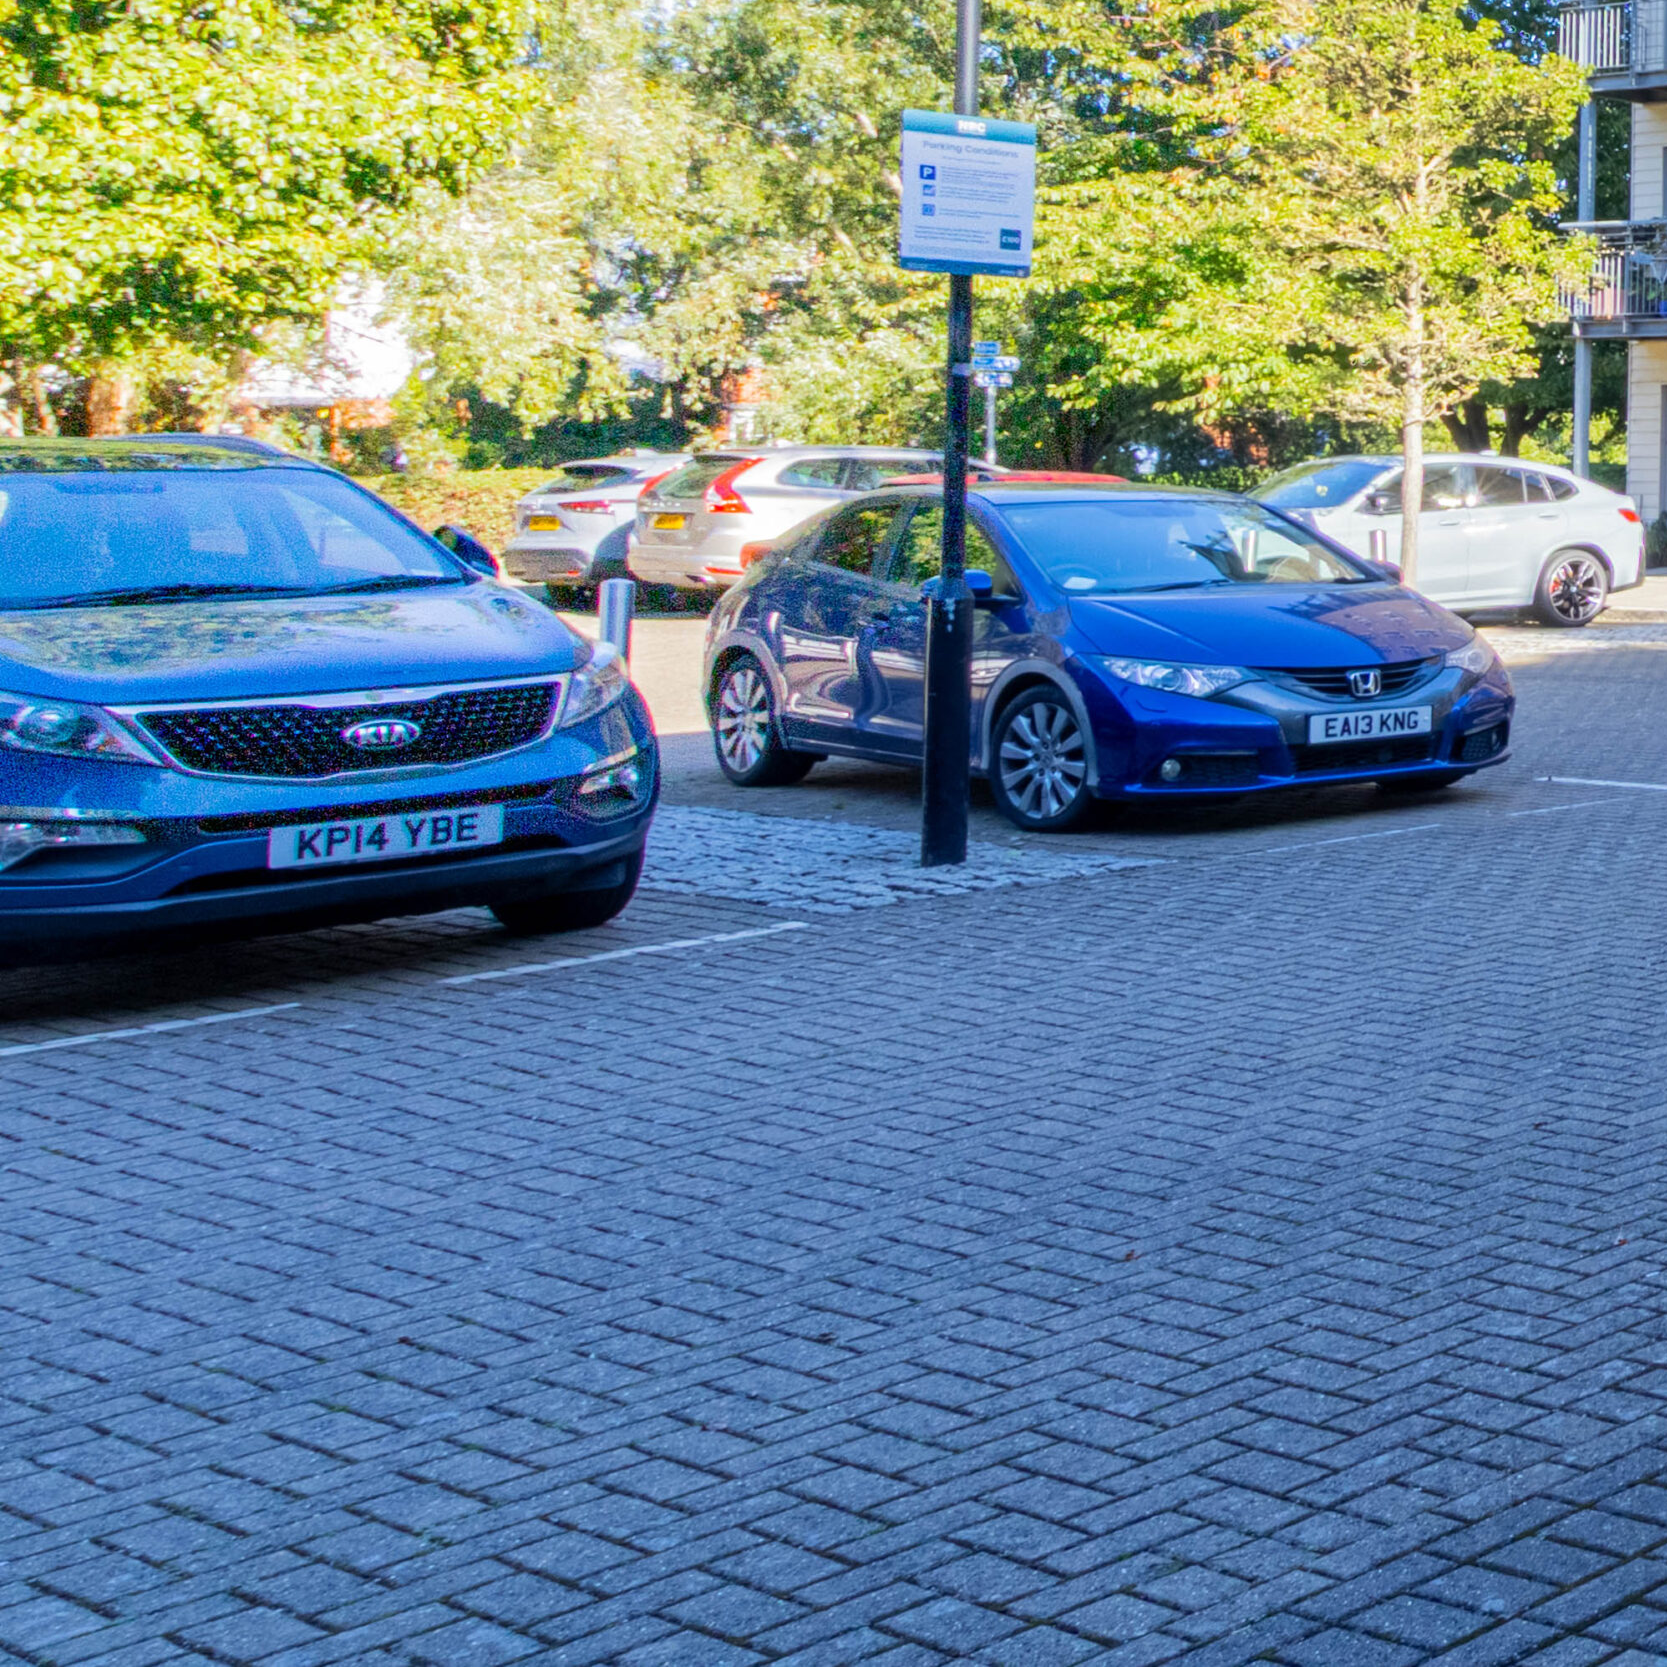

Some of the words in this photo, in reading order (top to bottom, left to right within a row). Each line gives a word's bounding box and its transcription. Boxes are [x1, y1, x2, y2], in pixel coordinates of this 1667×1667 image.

[922, 140, 963, 154] Parking
[965, 145, 1019, 158] Conditions
[356, 724, 411, 747] KIA
[1325, 715, 1373, 738] EA13
[1380, 711, 1419, 733] KNG
[296, 822, 390, 860] KP14
[405, 812, 480, 848] YBE
